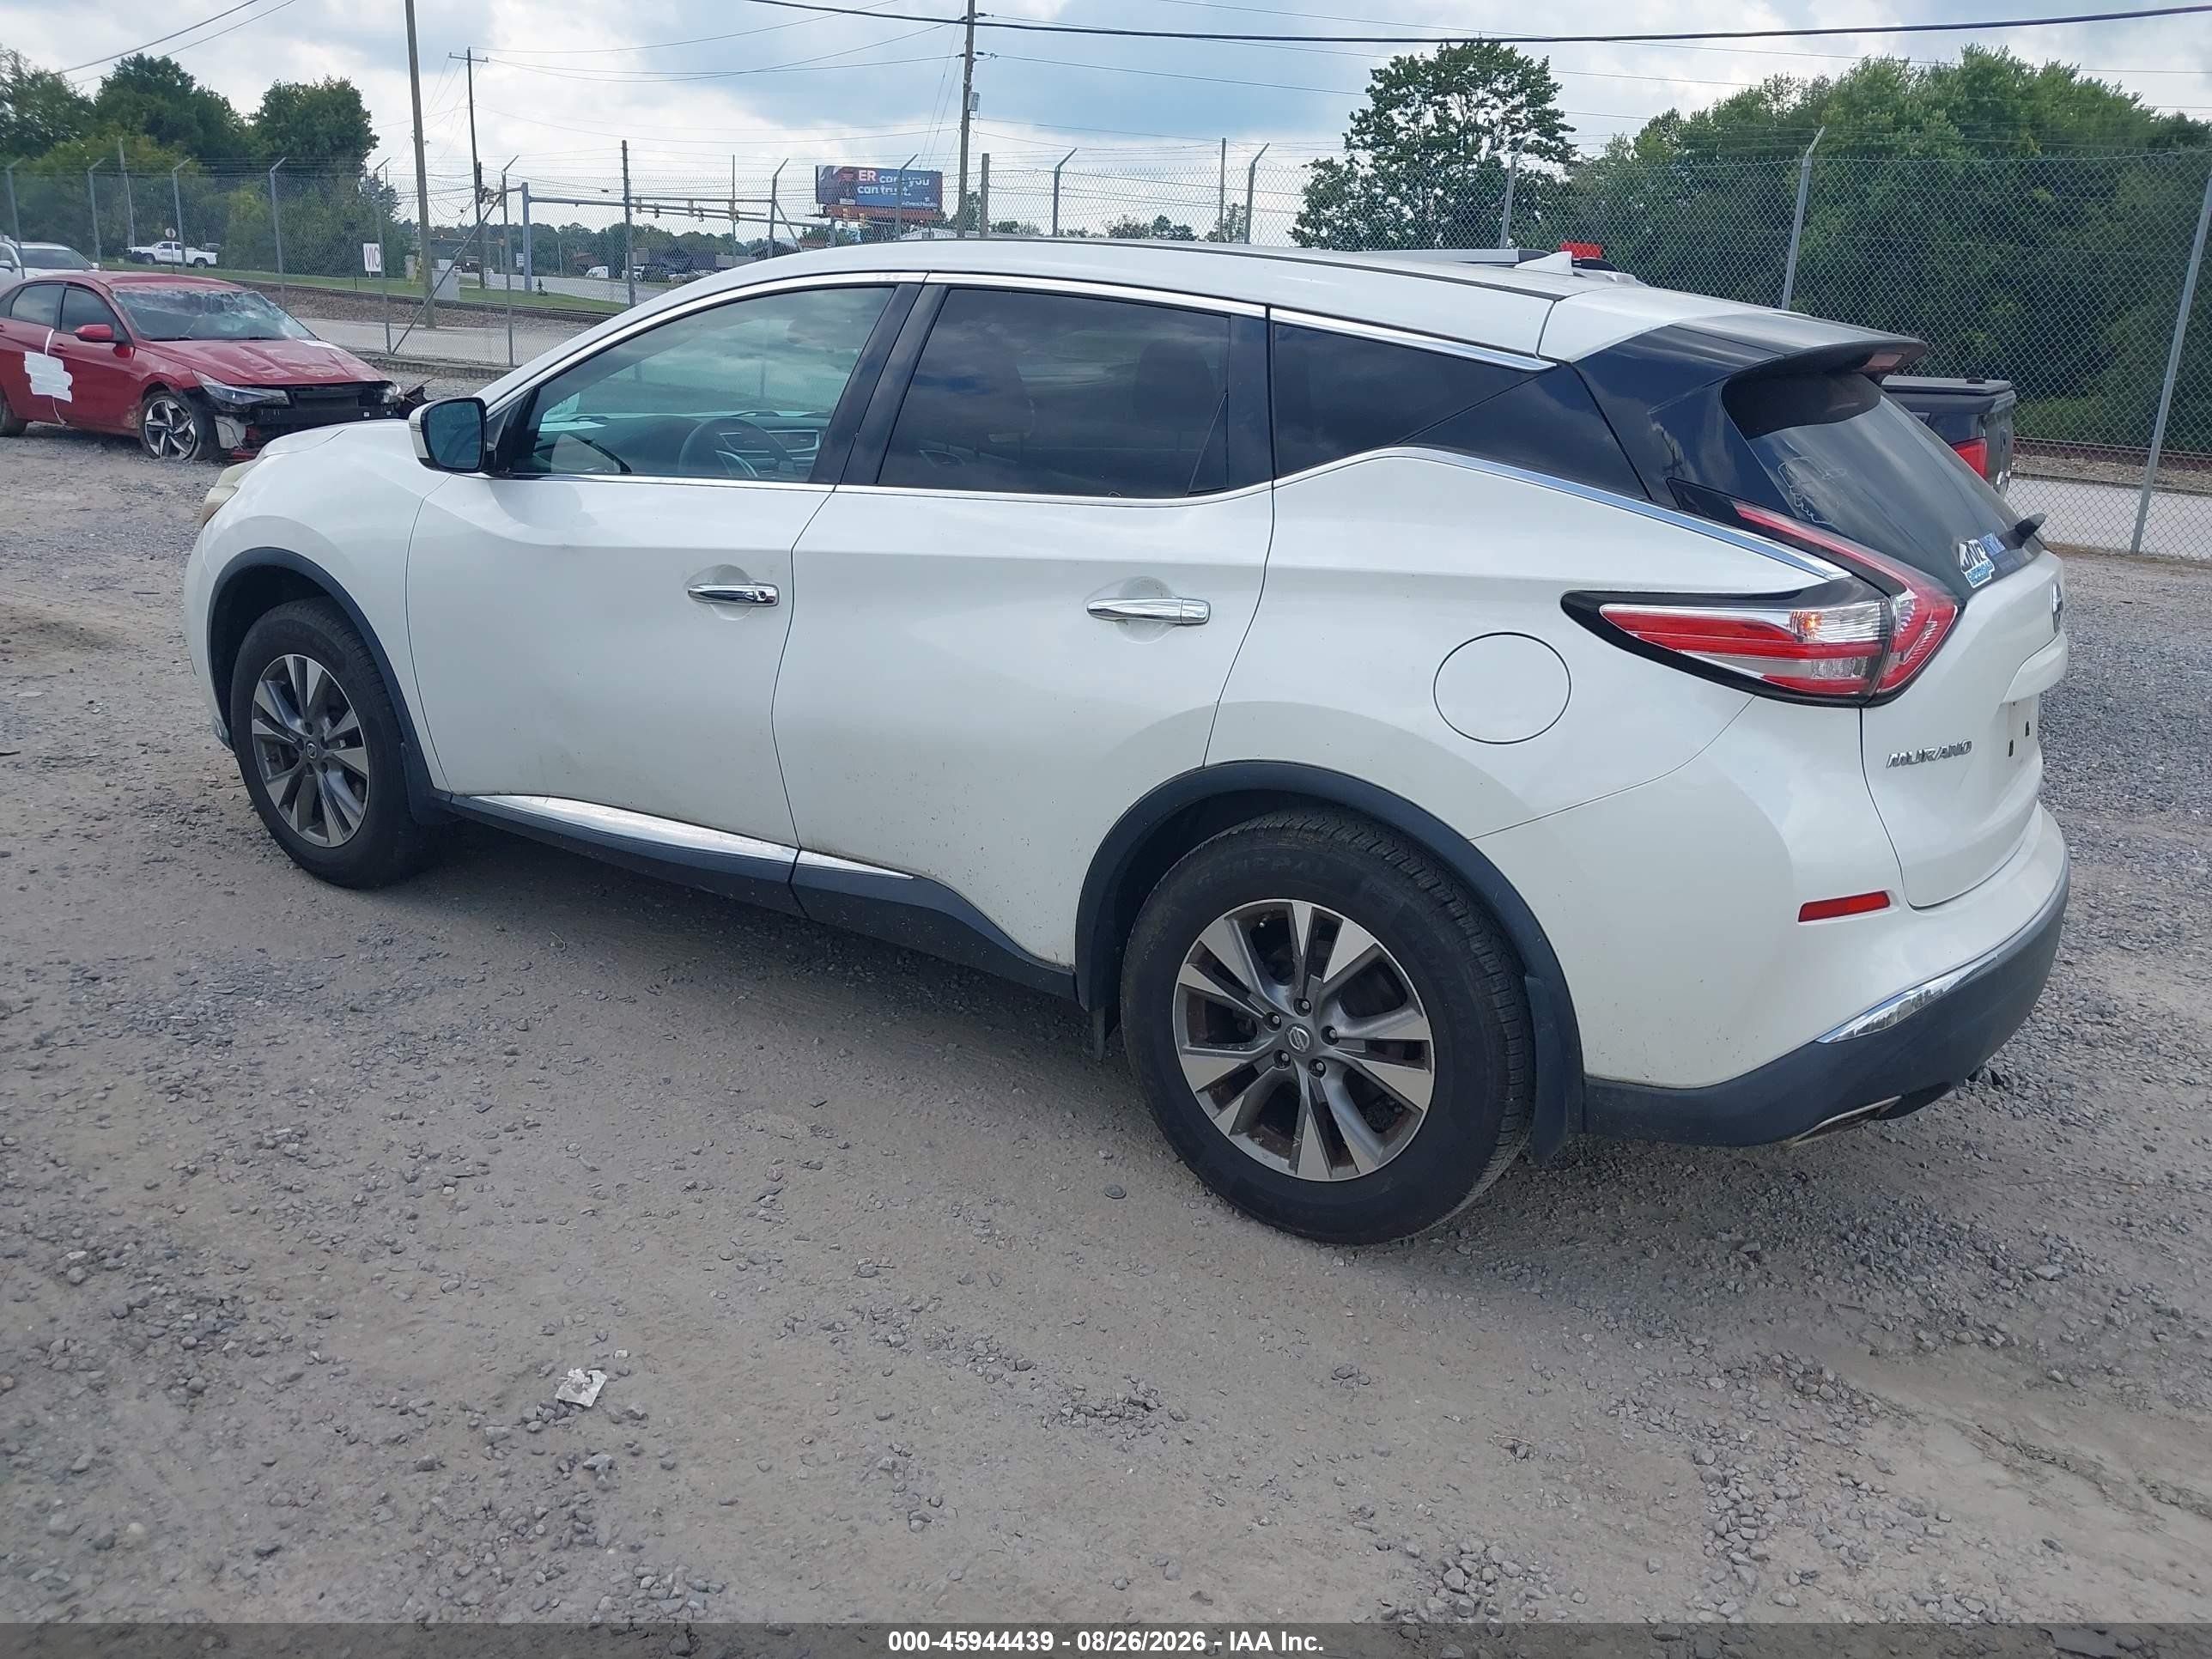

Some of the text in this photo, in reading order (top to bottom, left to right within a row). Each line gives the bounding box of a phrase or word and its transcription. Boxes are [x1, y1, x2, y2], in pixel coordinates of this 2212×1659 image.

[859, 169, 876, 182] ER
[908, 176, 930, 187] you
[857, 185, 878, 194] can
[1886, 739, 1972, 769] MURANO
